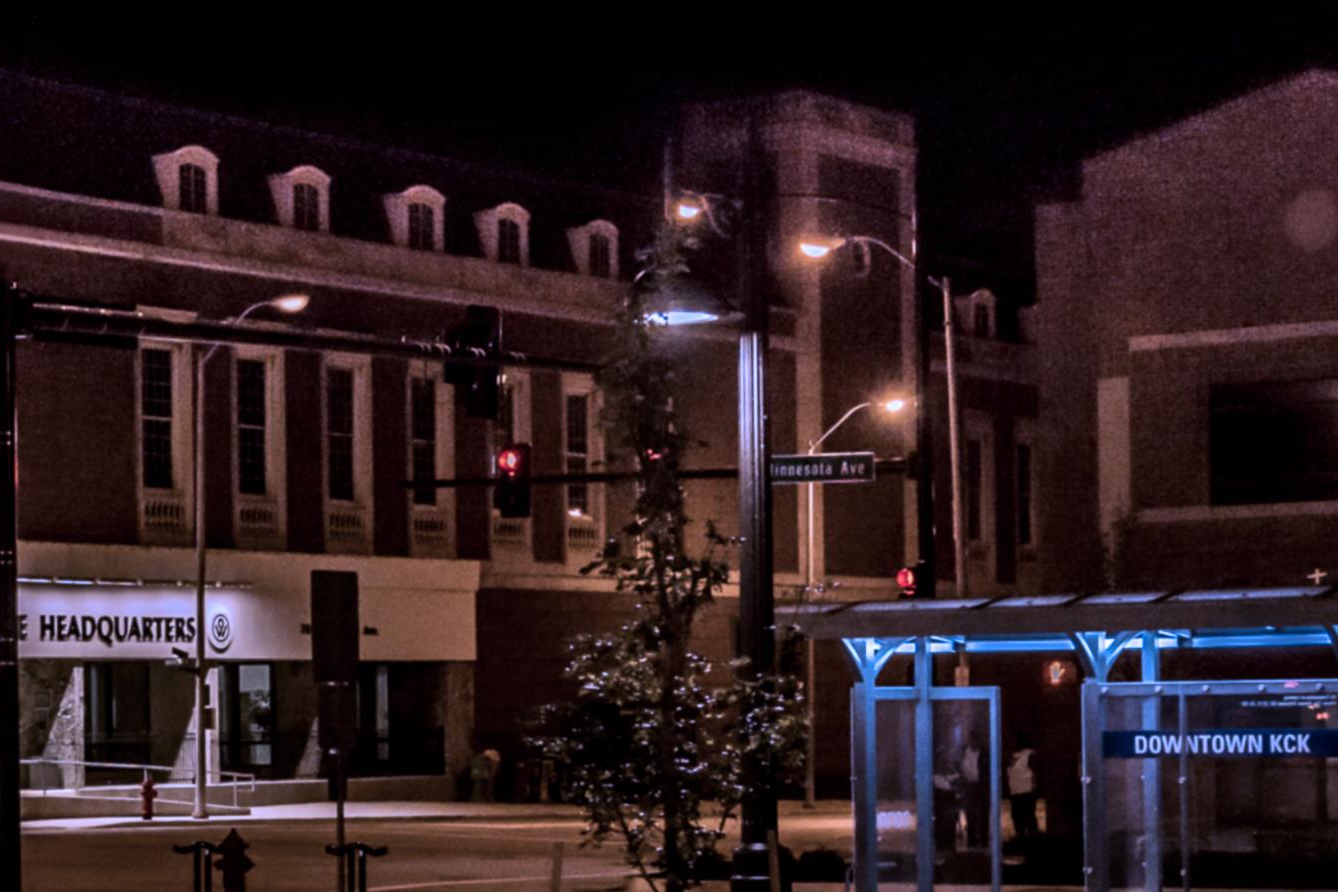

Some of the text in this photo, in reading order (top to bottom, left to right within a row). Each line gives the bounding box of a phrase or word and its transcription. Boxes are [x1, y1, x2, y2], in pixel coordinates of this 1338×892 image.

[840, 461, 865, 475] Ave
[39, 615, 197, 648] HEADQUARTERS
[1134, 733, 1311, 754] DOWNTOWN KCK
